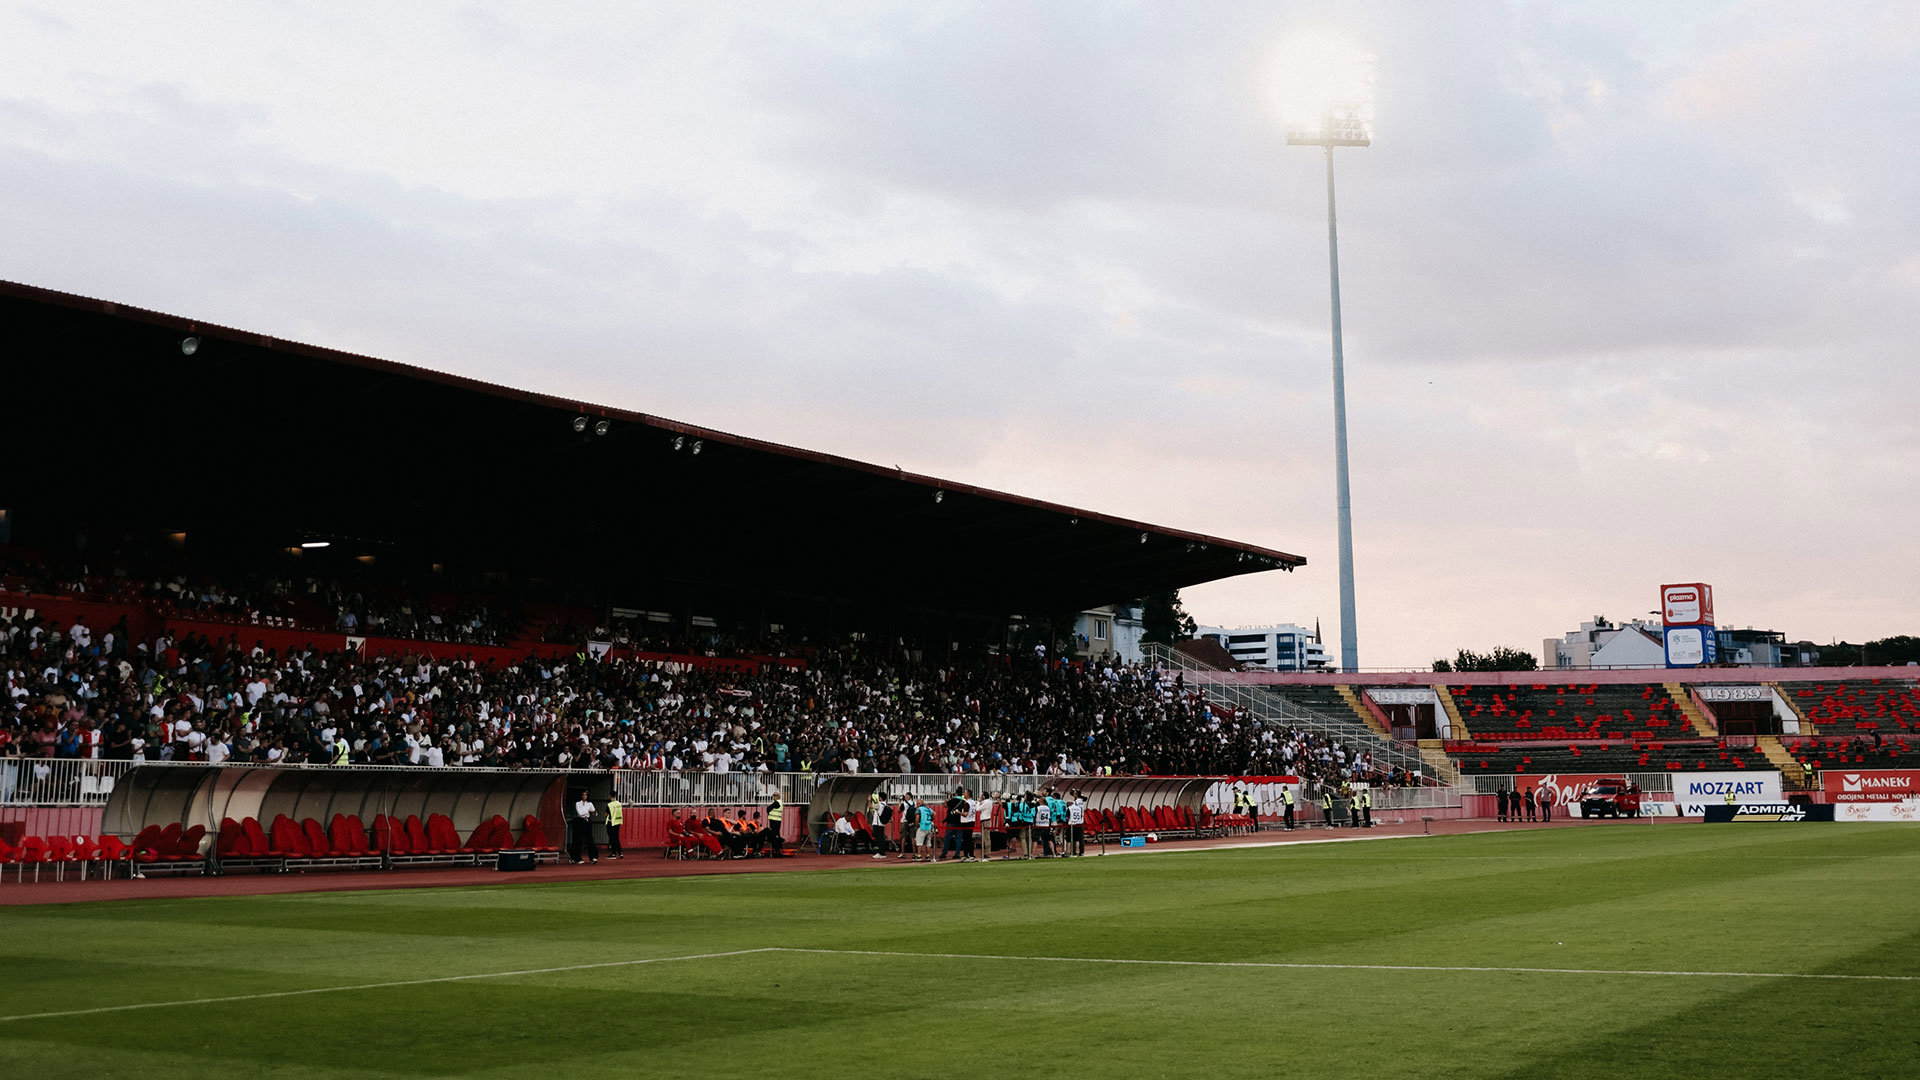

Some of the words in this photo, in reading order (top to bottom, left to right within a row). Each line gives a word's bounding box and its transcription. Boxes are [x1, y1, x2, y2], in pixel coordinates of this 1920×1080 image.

[1669, 594, 1693, 602] plazma
[1705, 687, 1761, 700] 1989
[1861, 777, 1912, 788] MANEKS
[1689, 781, 1764, 795] MOZZART
[1837, 793, 1865, 801] OBOJENI
[1736, 804, 1806, 814] ADMIRAL
[1780, 814, 1806, 822] BET
